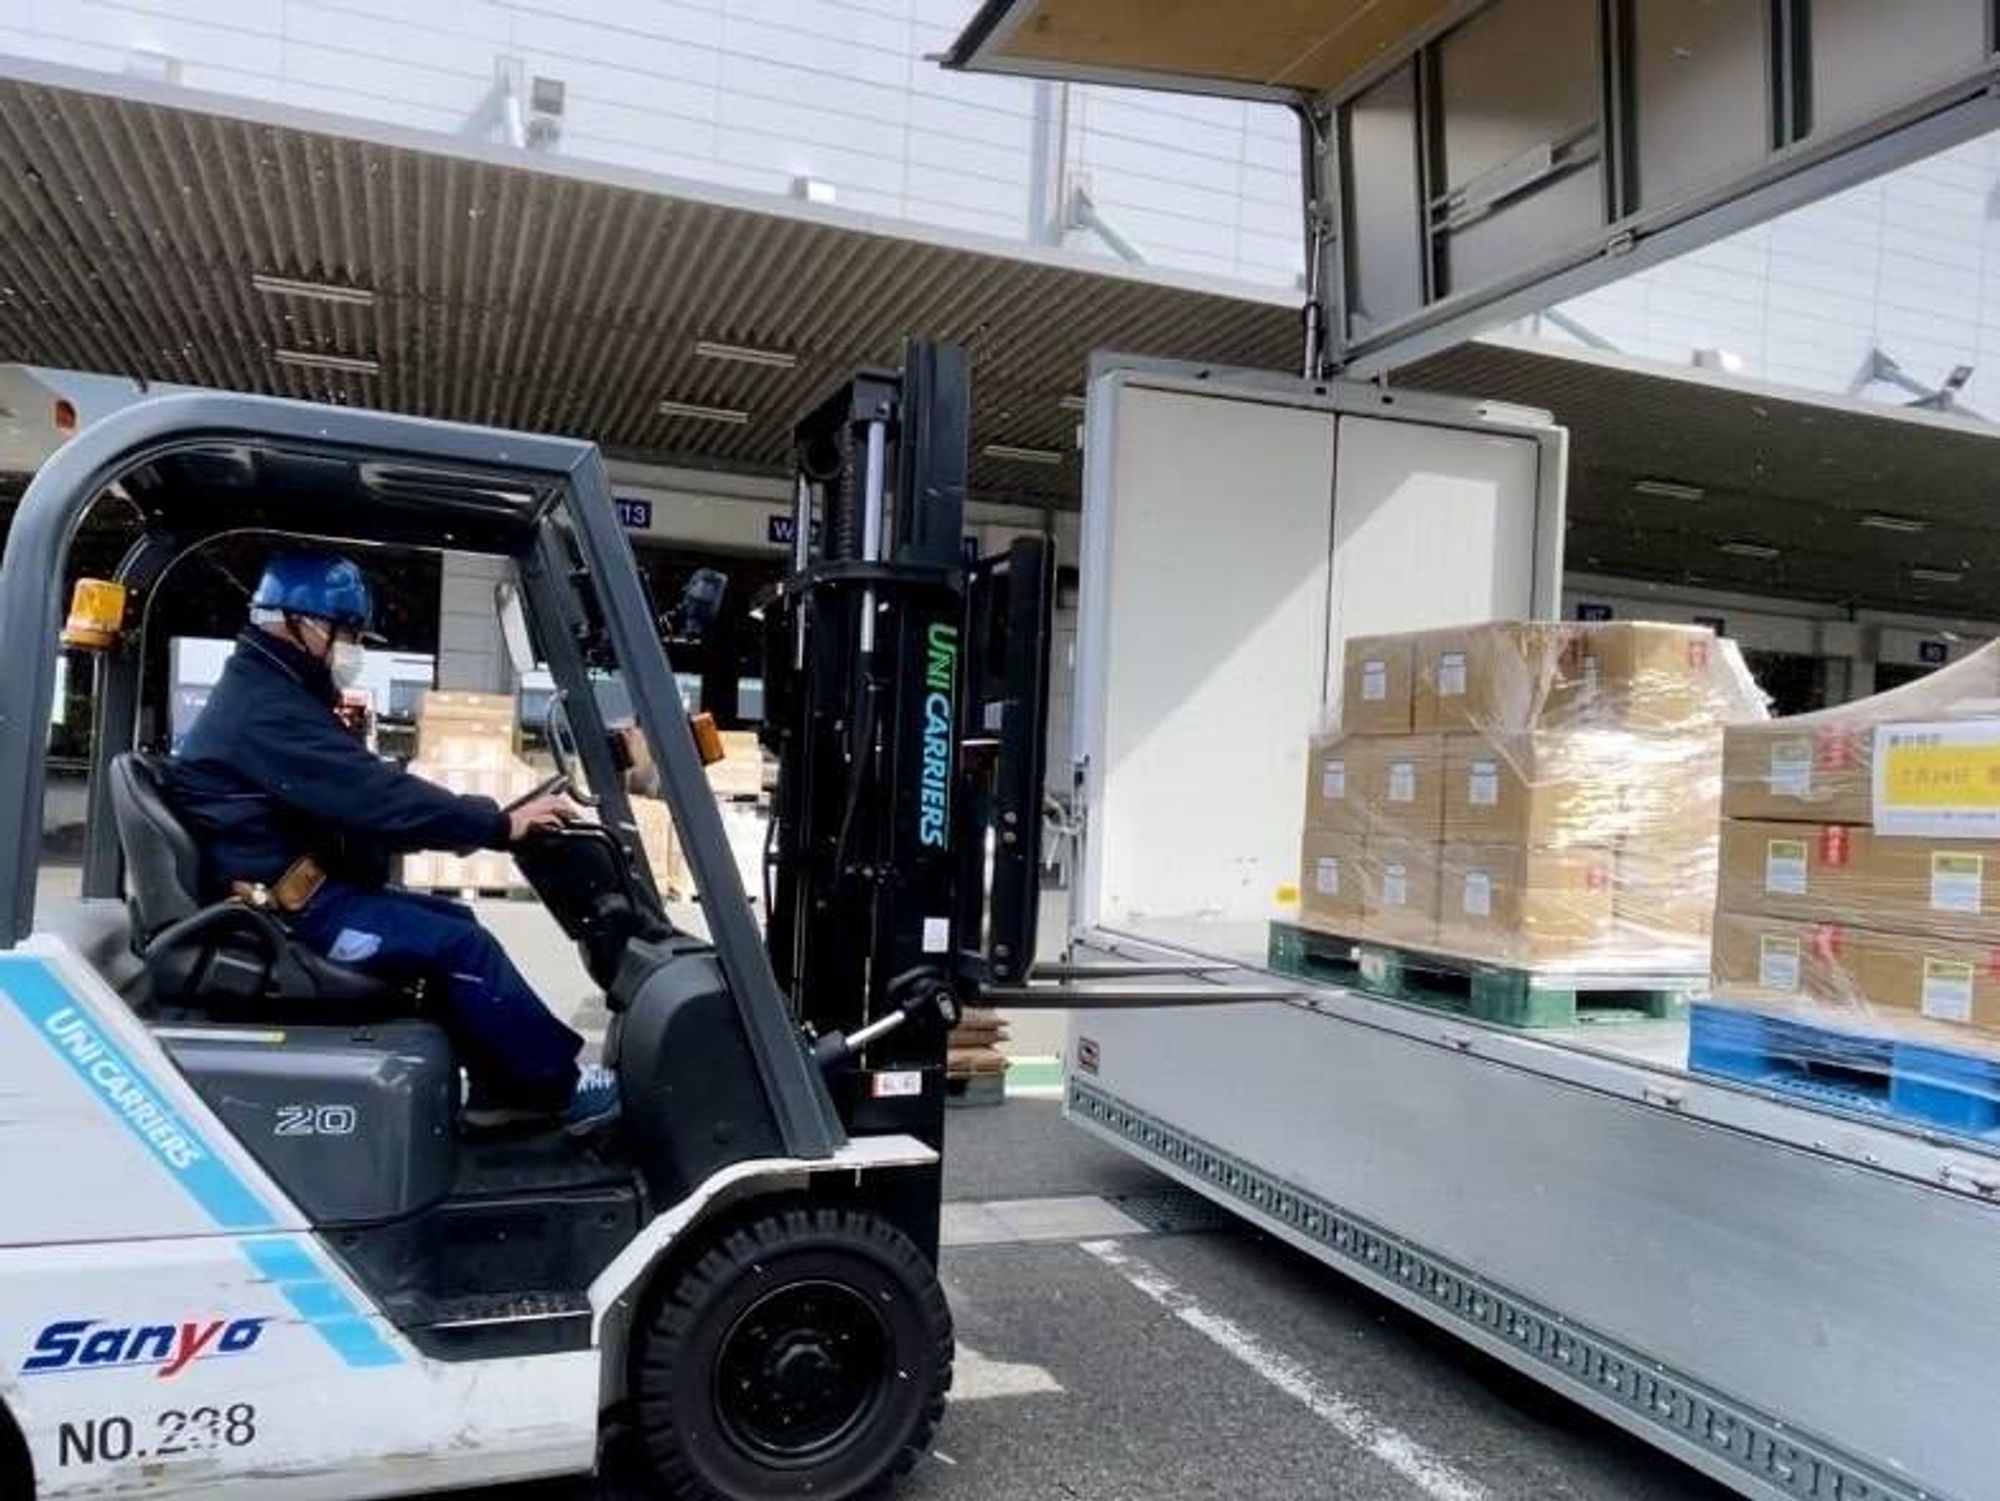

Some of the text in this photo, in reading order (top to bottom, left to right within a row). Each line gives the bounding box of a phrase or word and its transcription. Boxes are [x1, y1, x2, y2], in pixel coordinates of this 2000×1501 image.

[616, 503, 646, 524] 13
[920, 622, 957, 847] UNICARRIERS
[45, 1007, 199, 1170] UNICARRIERS
[275, 1104, 356, 1135] 20
[22, 1317, 274, 1377] Sanyo
